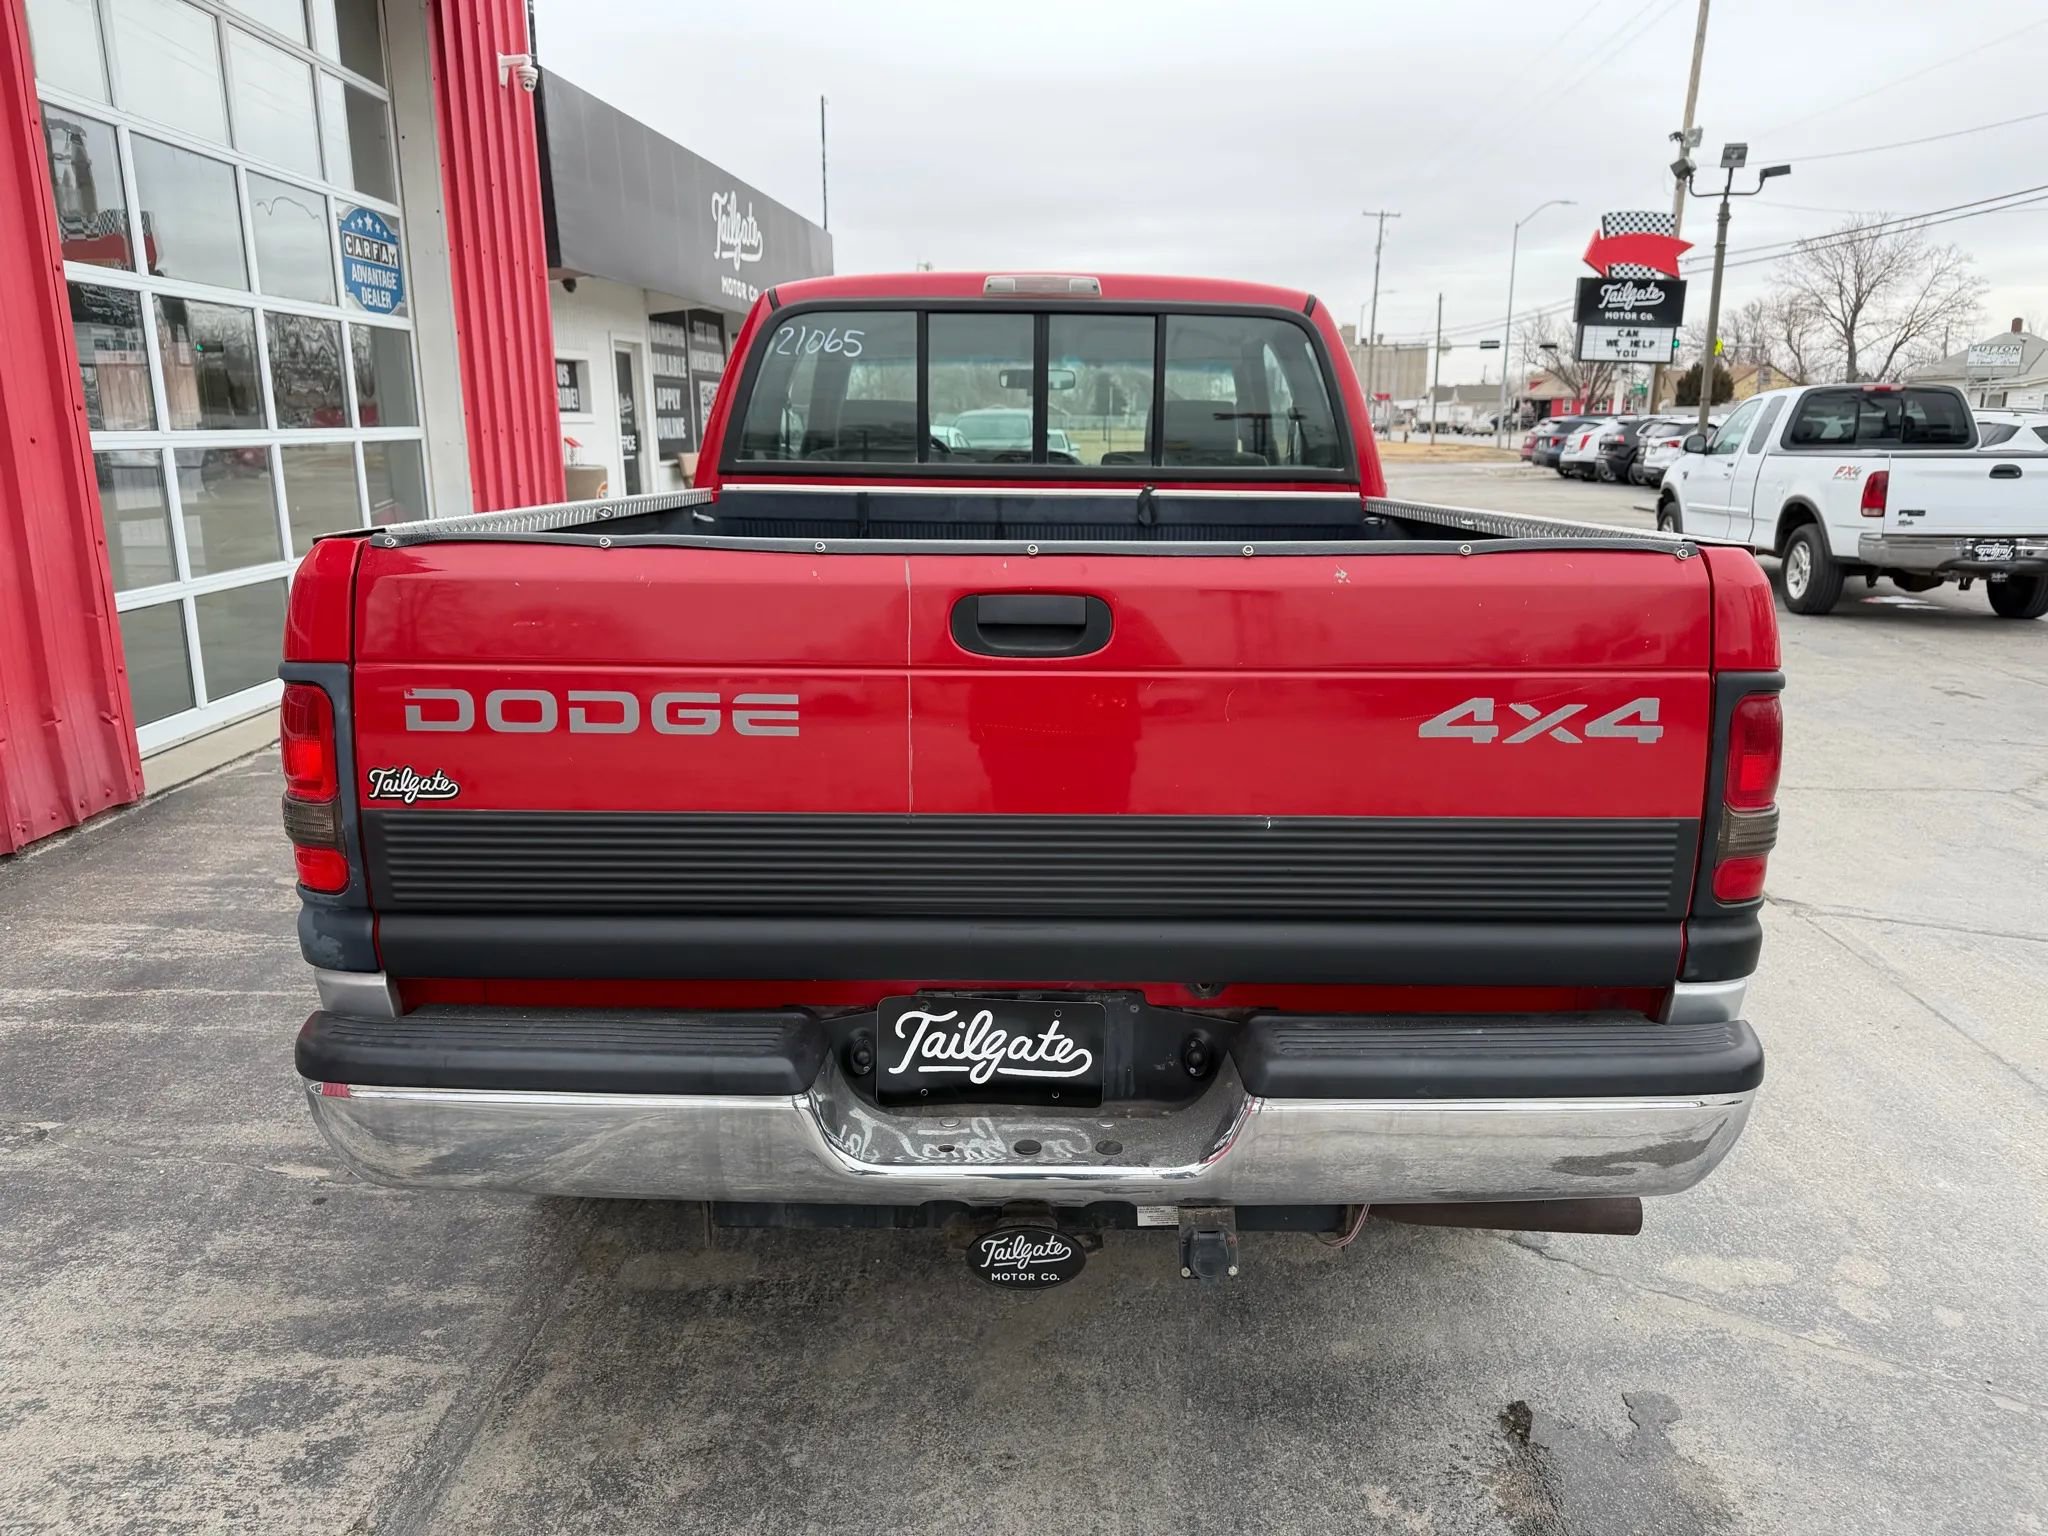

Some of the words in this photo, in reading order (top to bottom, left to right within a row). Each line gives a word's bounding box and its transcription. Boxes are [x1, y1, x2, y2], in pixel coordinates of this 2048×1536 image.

[711, 190, 763, 272] Tailgate
[344, 235, 399, 269] CARFAX
[351, 263, 399, 291] ADVANTAGE
[721, 275, 747, 300] MOTOR
[361, 286, 393, 309] DEALER
[1598, 281, 1665, 310] Tailgate
[1605, 311, 1637, 320] MOTOR
[1640, 312, 1655, 321] CO.
[776, 326, 865, 358] 21065
[1606, 339, 1619, 347] WE
[1630, 340, 1655, 348] HELP
[1617, 329, 1639, 337] CAN
[1971, 345, 2020, 353] SUTTON
[656, 387, 681, 410] APPLY
[657, 417, 686, 440] ONLINE
[403, 688, 800, 737] DODGE
[1418, 697, 1664, 744] 4X4
[368, 766, 459, 804] Tailgate
[888, 1009, 1093, 1084] Tailgate
[979, 1234, 1072, 1269] Tailgate
[991, 1272, 1035, 1282] MOTOR
